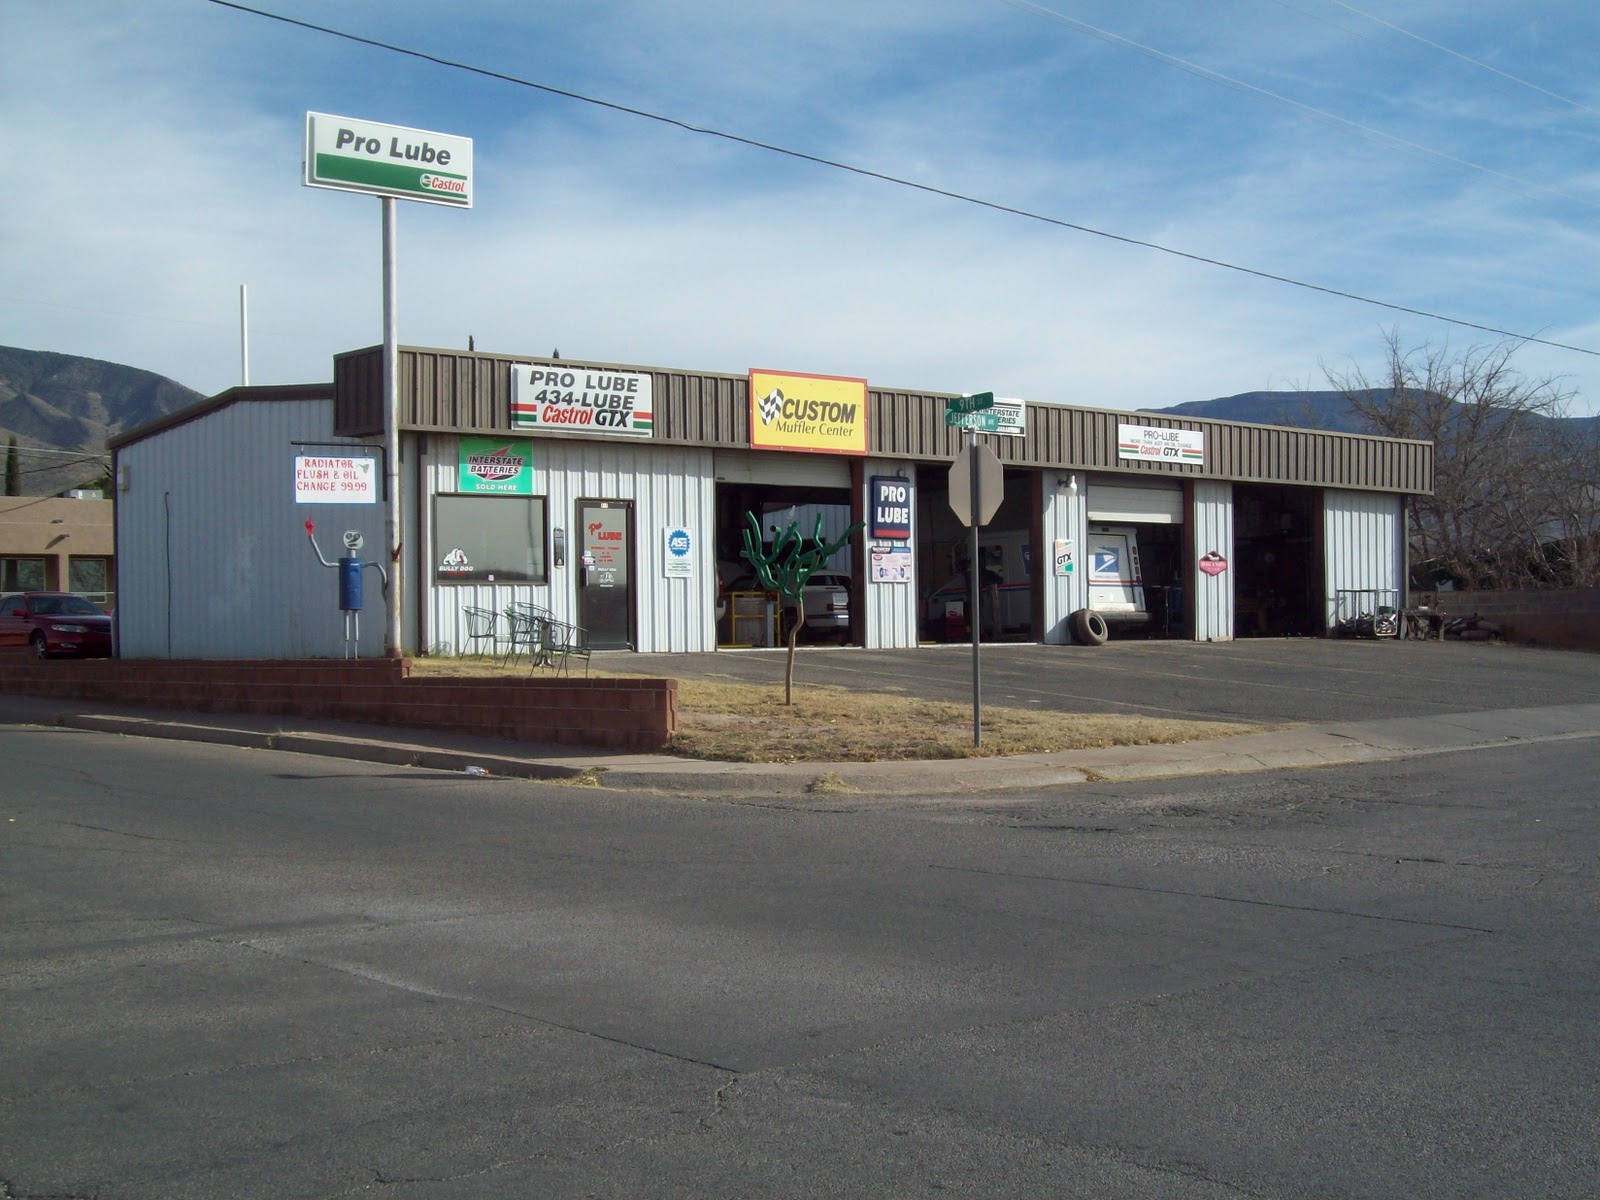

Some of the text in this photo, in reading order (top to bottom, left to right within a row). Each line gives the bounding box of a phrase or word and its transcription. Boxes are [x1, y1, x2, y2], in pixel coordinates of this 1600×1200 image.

[336, 128, 451, 166] Pro Lube
[431, 177, 465, 192] Castrol
[529, 370, 639, 393] PRO LUBE
[534, 389, 635, 410] 434-LUBE
[959, 397, 975, 410] 9TH
[542, 404, 632, 428] Castrol GTX
[782, 398, 857, 424] CUSTOM
[950, 412, 986, 427] JEFFERSON
[998, 416, 1016, 424] ERIES
[776, 420, 853, 437] Muffler Center
[1143, 430, 1180, 442] PRO-LUBE
[1140, 445, 1180, 457] Castrol GTX
[304, 458, 354, 469] RADIATOR
[468, 456, 523, 465] INTERSTATE
[297, 469, 329, 480] FLUSH
[343, 470, 358, 480] OIL
[470, 465, 519, 474] BATTERIES
[296, 481, 336, 491] CHANGE
[880, 485, 906, 503] PRO
[877, 506, 909, 524] LUBE
[597, 531, 622, 541] LUBE
[670, 537, 688, 547] ASE
[1057, 552, 1072, 565] GTX
